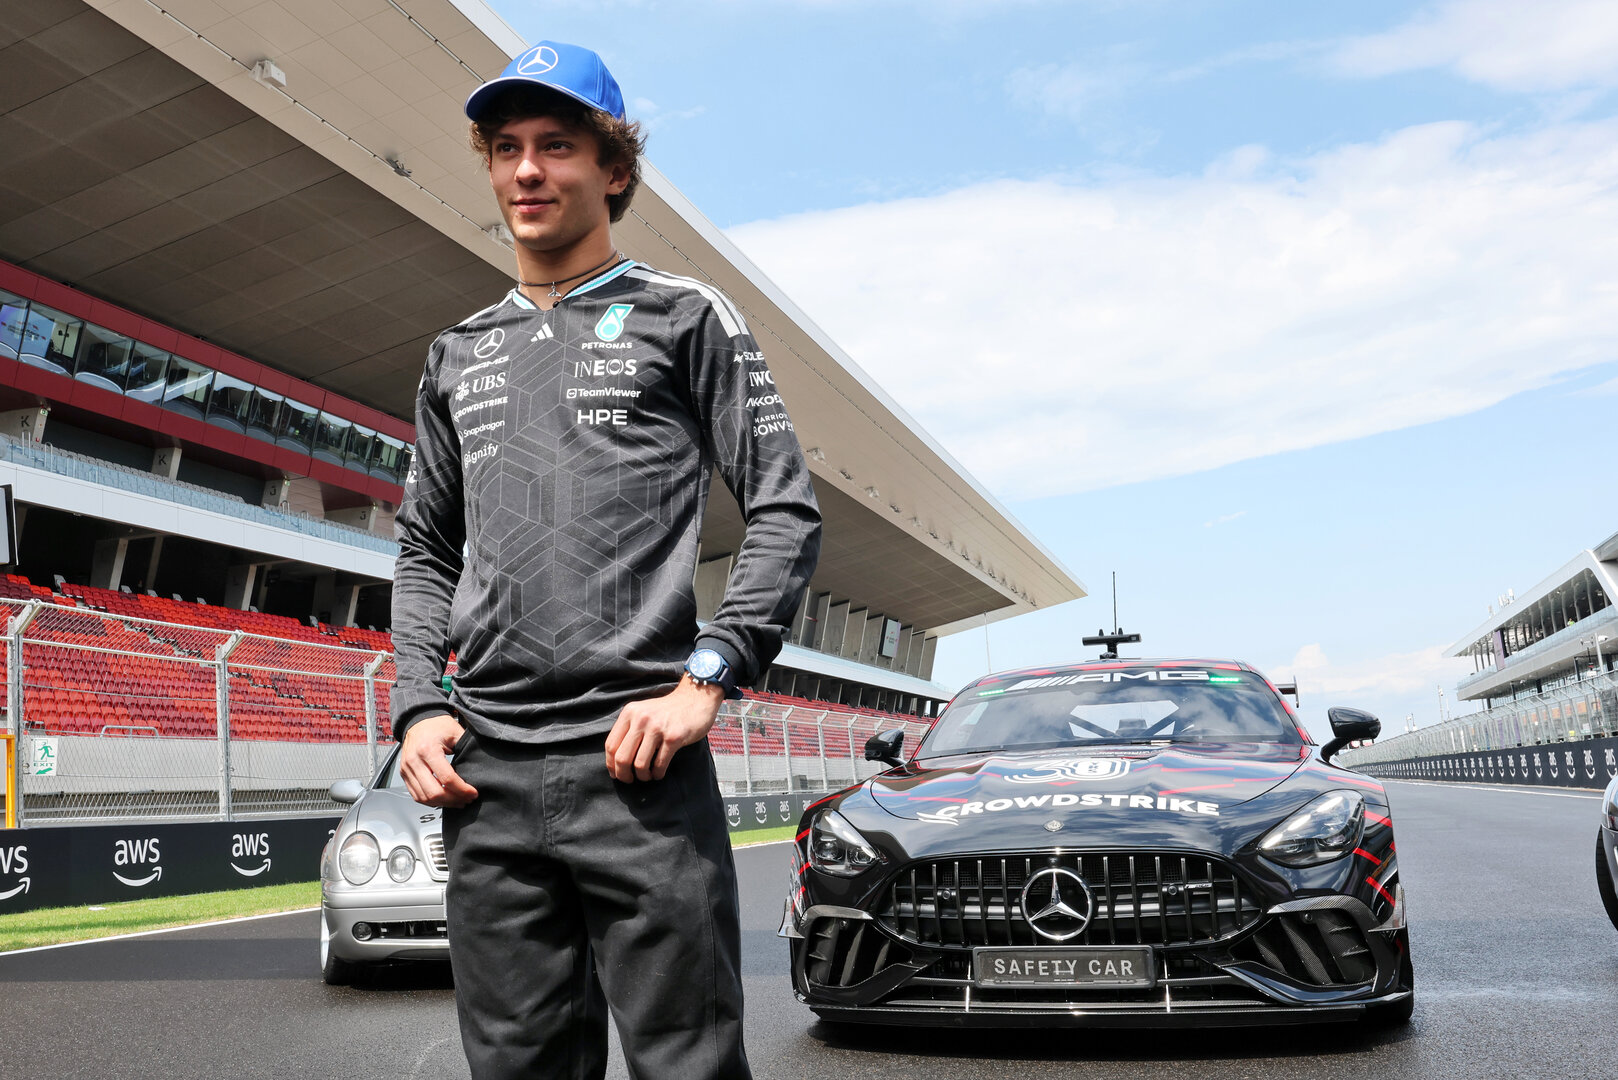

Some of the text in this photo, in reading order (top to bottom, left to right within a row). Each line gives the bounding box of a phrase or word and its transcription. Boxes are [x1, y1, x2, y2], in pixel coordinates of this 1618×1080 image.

[582, 342, 633, 350] PETRONAS
[743, 351, 765, 361] SOLE
[574, 358, 637, 378] INEOS
[472, 372, 506, 393] UBS
[578, 387, 642, 398] TeamViewer
[746, 394, 785, 408] AKKOD
[453, 396, 508, 422] CROWDSTRIKE
[577, 409, 628, 425] HPE
[21, 415, 31, 428] K
[755, 413, 788, 423] MARRIO
[463, 420, 505, 438] Snapdragon
[753, 421, 794, 437] BONV
[1058, 669, 1212, 686] AMG
[925, 793, 1220, 821] CROWDSTRIKE
[114, 837, 160, 866] aws
[232, 832, 270, 858] aws
[0, 845, 28, 874] ws
[994, 958, 1134, 976] SAFETY CAR
